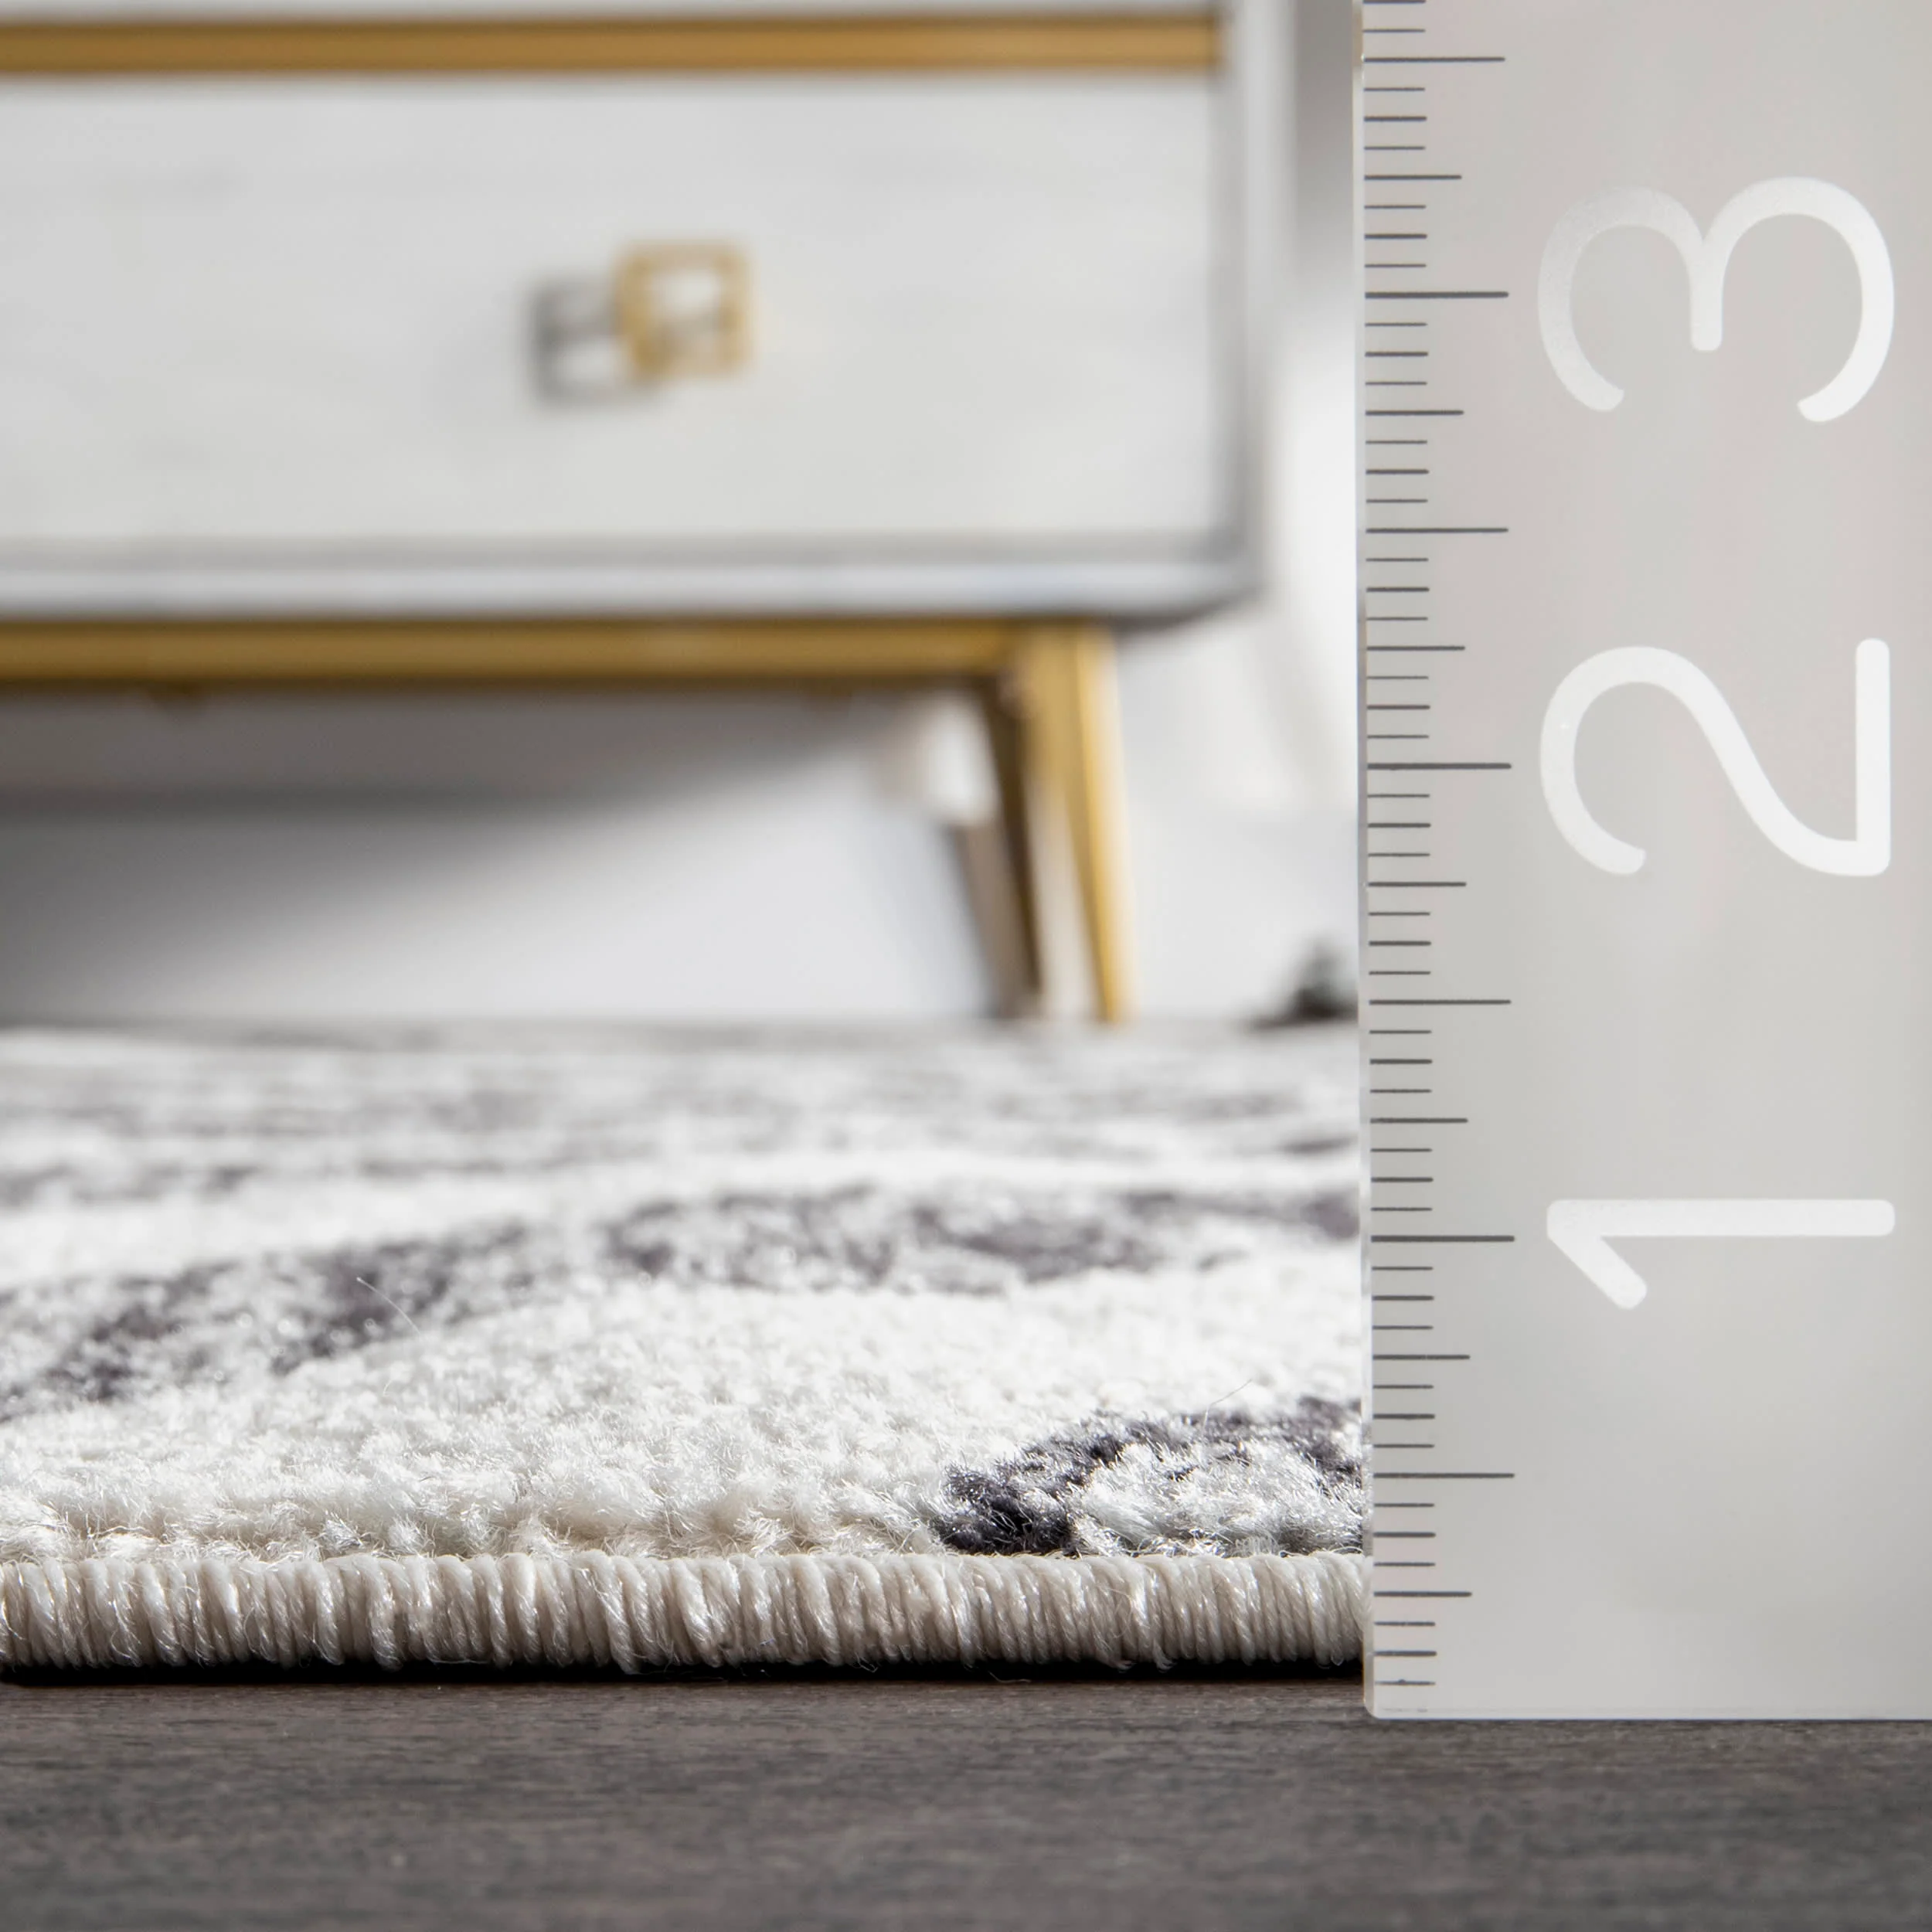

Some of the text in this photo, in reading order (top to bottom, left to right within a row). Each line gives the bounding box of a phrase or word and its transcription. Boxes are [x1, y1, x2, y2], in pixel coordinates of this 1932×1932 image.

[1538, 176, 1894, 423] 3
[1540, 638, 1890, 876] 2
[1546, 1199, 1895, 1309] 1
